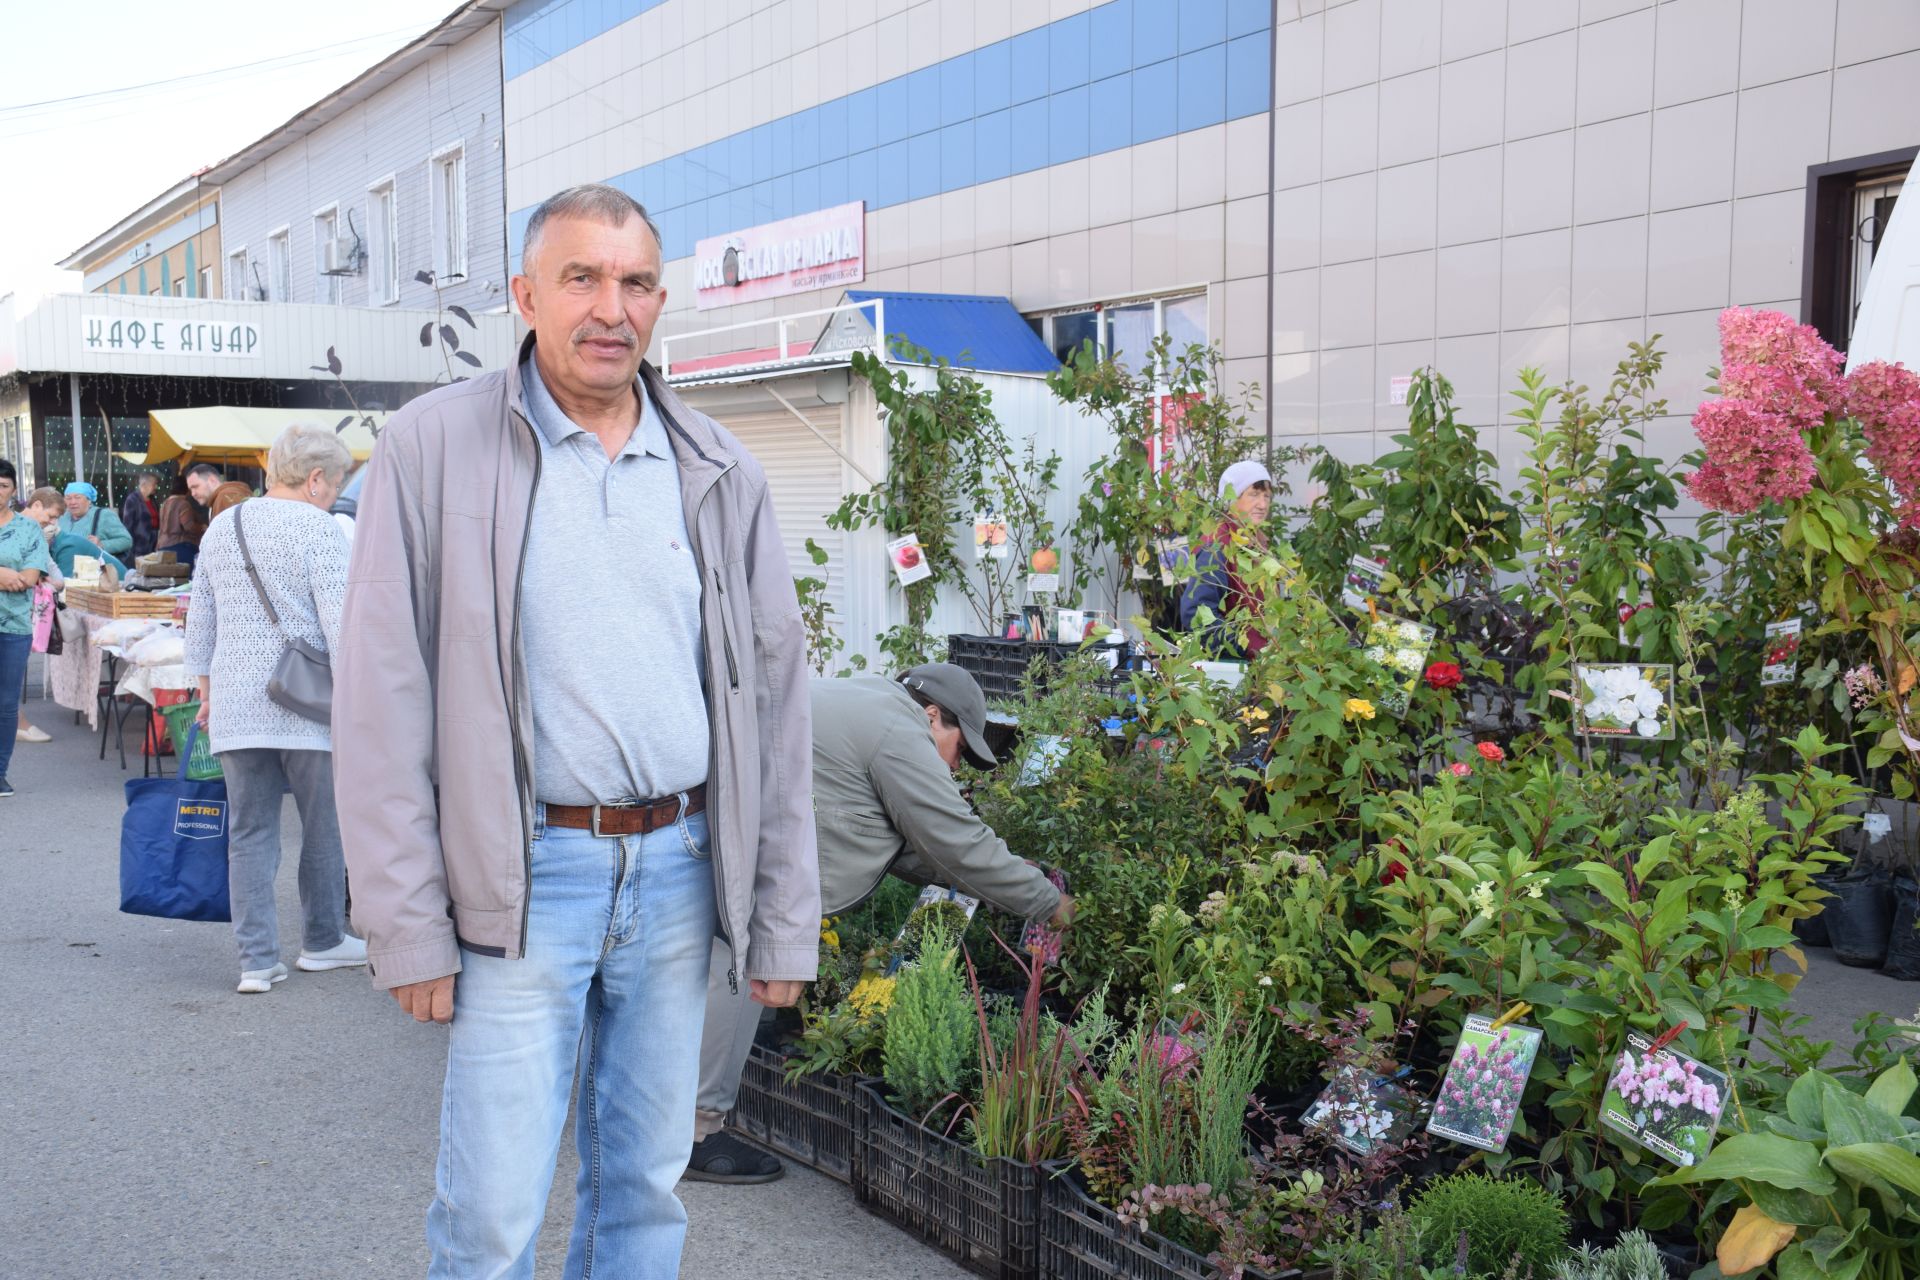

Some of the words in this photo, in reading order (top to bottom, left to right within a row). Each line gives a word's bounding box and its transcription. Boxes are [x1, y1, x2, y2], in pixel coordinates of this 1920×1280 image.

[784, 226, 859, 272] ЯРМАРКА
[86, 319, 165, 350] КАФЕ
[180, 323, 258, 354] ЯГУАР
[180, 806, 220, 816] METRO
[177, 822, 220, 831] PROFESSIONAL
[1465, 1025, 1499, 1036] САМАРСКАЯ
[1469, 1018, 1490, 1028] ЛИДИЯ
[1431, 1123, 1458, 1137] гортензия
[1459, 1132, 1493, 1146] метельчатая
[1608, 1110, 1638, 1131] гортензия
[1645, 1131, 1684, 1157] метельчатая
